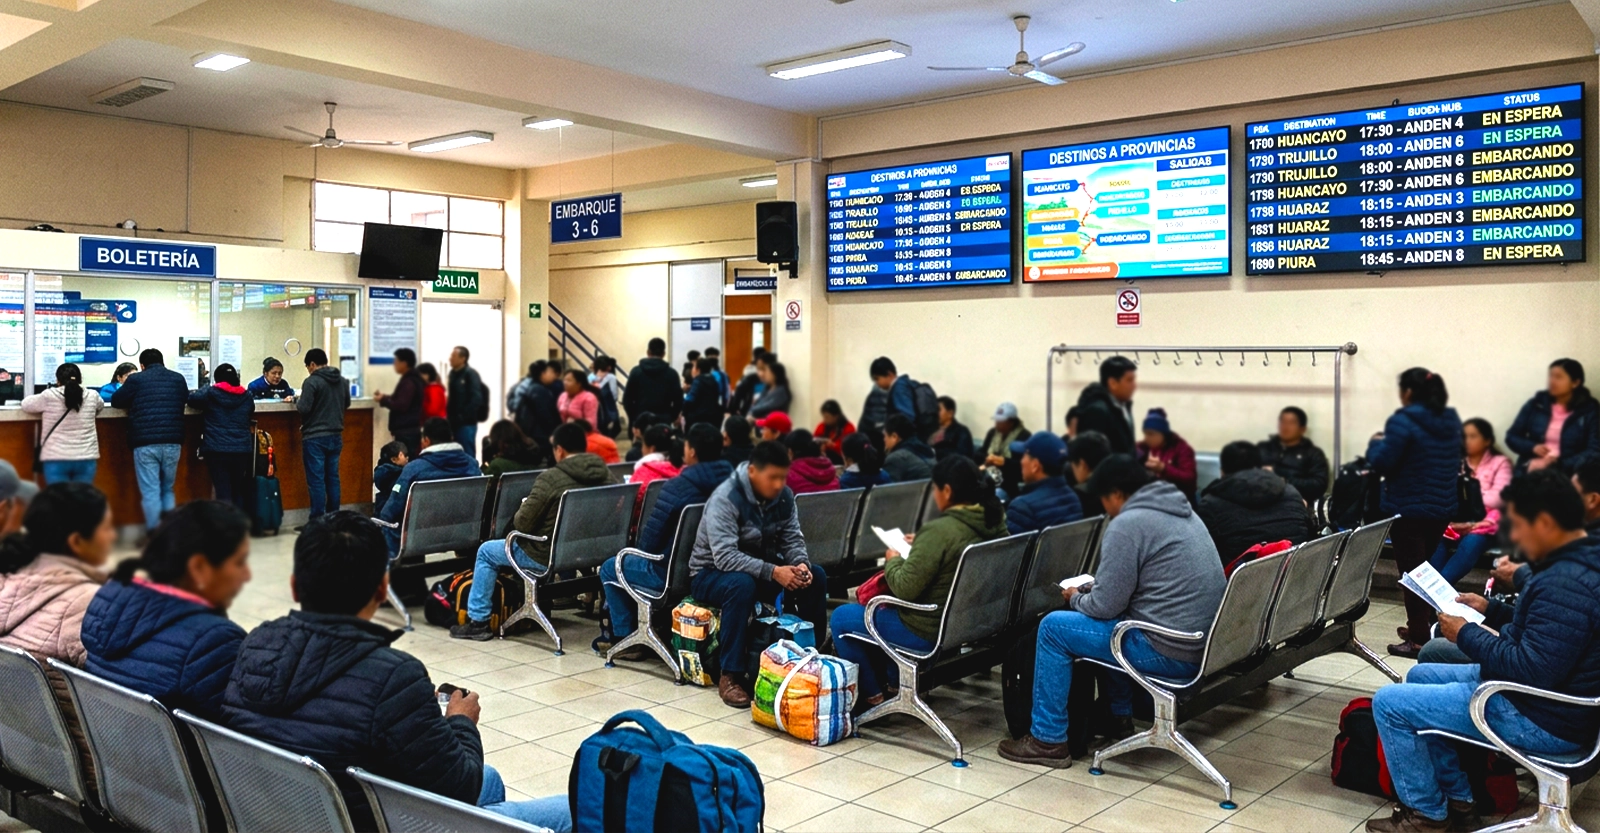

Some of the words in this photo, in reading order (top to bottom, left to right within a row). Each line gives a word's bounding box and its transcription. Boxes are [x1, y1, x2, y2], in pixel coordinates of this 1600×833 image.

[1278, 129, 1346, 147] HUANCAYO
[1404, 117, 1452, 134] ANDEN
[1455, 116, 1464, 128] 4
[1482, 112, 1501, 126] EN
[1505, 105, 1563, 123] ESPERA
[1049, 147, 1106, 165] DESTINOS
[1109, 146, 1118, 158] A
[1121, 137, 1196, 157] PROVINCIAS
[1278, 148, 1337, 165] TRUJILLO
[1360, 142, 1394, 156] 18:00
[1404, 136, 1452, 152] ANDEN
[1455, 135, 1464, 147] 6
[1483, 131, 1501, 144] EN
[1505, 125, 1563, 142] ESPERA
[1278, 166, 1338, 182] TRUJILLO
[1360, 161, 1394, 175] 18:00
[1404, 154, 1452, 171] ANDEN
[1455, 154, 1464, 166] 6
[1472, 143, 1574, 165] EMBARCANDO
[1278, 182, 1347, 199] HUANCAYO
[1404, 173, 1452, 190] ANDEN
[1455, 172, 1464, 185] 6
[1472, 163, 1574, 184] EMBARCANDO
[556, 198, 616, 219] EMBARQUE
[1278, 202, 1329, 216] HUARAZ
[1360, 198, 1394, 211] 18:15
[1404, 192, 1452, 208] ANDEN
[1456, 192, 1464, 204] 3
[1473, 184, 1574, 203] EMBARCANDO
[572, 221, 579, 238] 3
[591, 219, 599, 236] 6
[1278, 220, 1330, 234] HUARAZ
[1360, 216, 1394, 229] 18:15
[1404, 212, 1452, 226] ANDEN
[1456, 211, 1464, 223] 3
[1473, 203, 1574, 222] EMBARCANDO
[1278, 237, 1330, 251] HUARAZ
[1360, 234, 1394, 247] 18:15
[1404, 230, 1452, 245] ANDEN
[1456, 230, 1464, 242] 3
[1473, 223, 1574, 241] EMBARCANDO
[97, 247, 200, 268] BOLETERÍA
[1278, 256, 1316, 269] PIURA
[1360, 252, 1394, 265] 18:45
[1404, 250, 1452, 263] ANDEN
[1456, 249, 1464, 261] 8
[1483, 247, 1502, 260] EN
[1506, 244, 1564, 259] ESPERA
